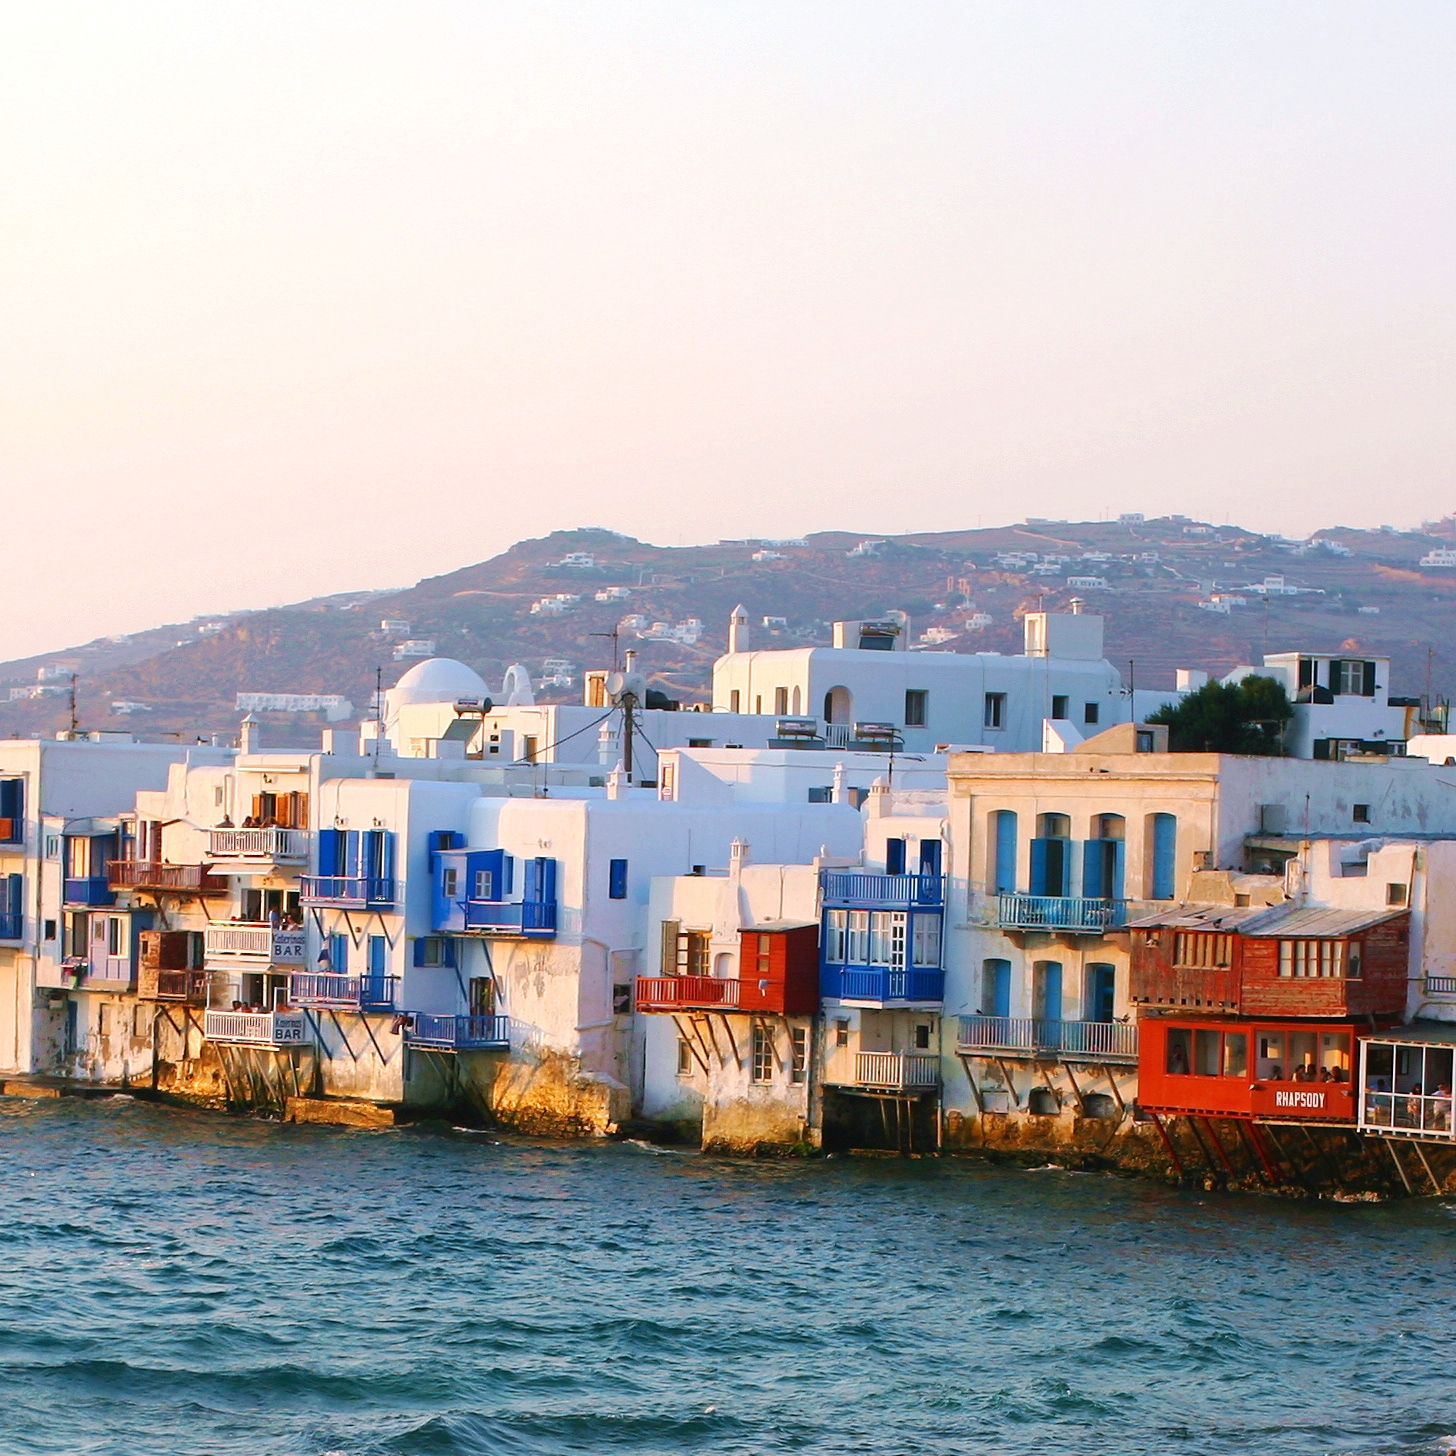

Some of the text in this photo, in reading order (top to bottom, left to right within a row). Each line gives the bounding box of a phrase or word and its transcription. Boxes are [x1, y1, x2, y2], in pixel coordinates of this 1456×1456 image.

[274, 944, 302, 956] BAR
[275, 1029, 301, 1039] BAR
[1276, 1091, 1325, 1108] RHAPSODY
